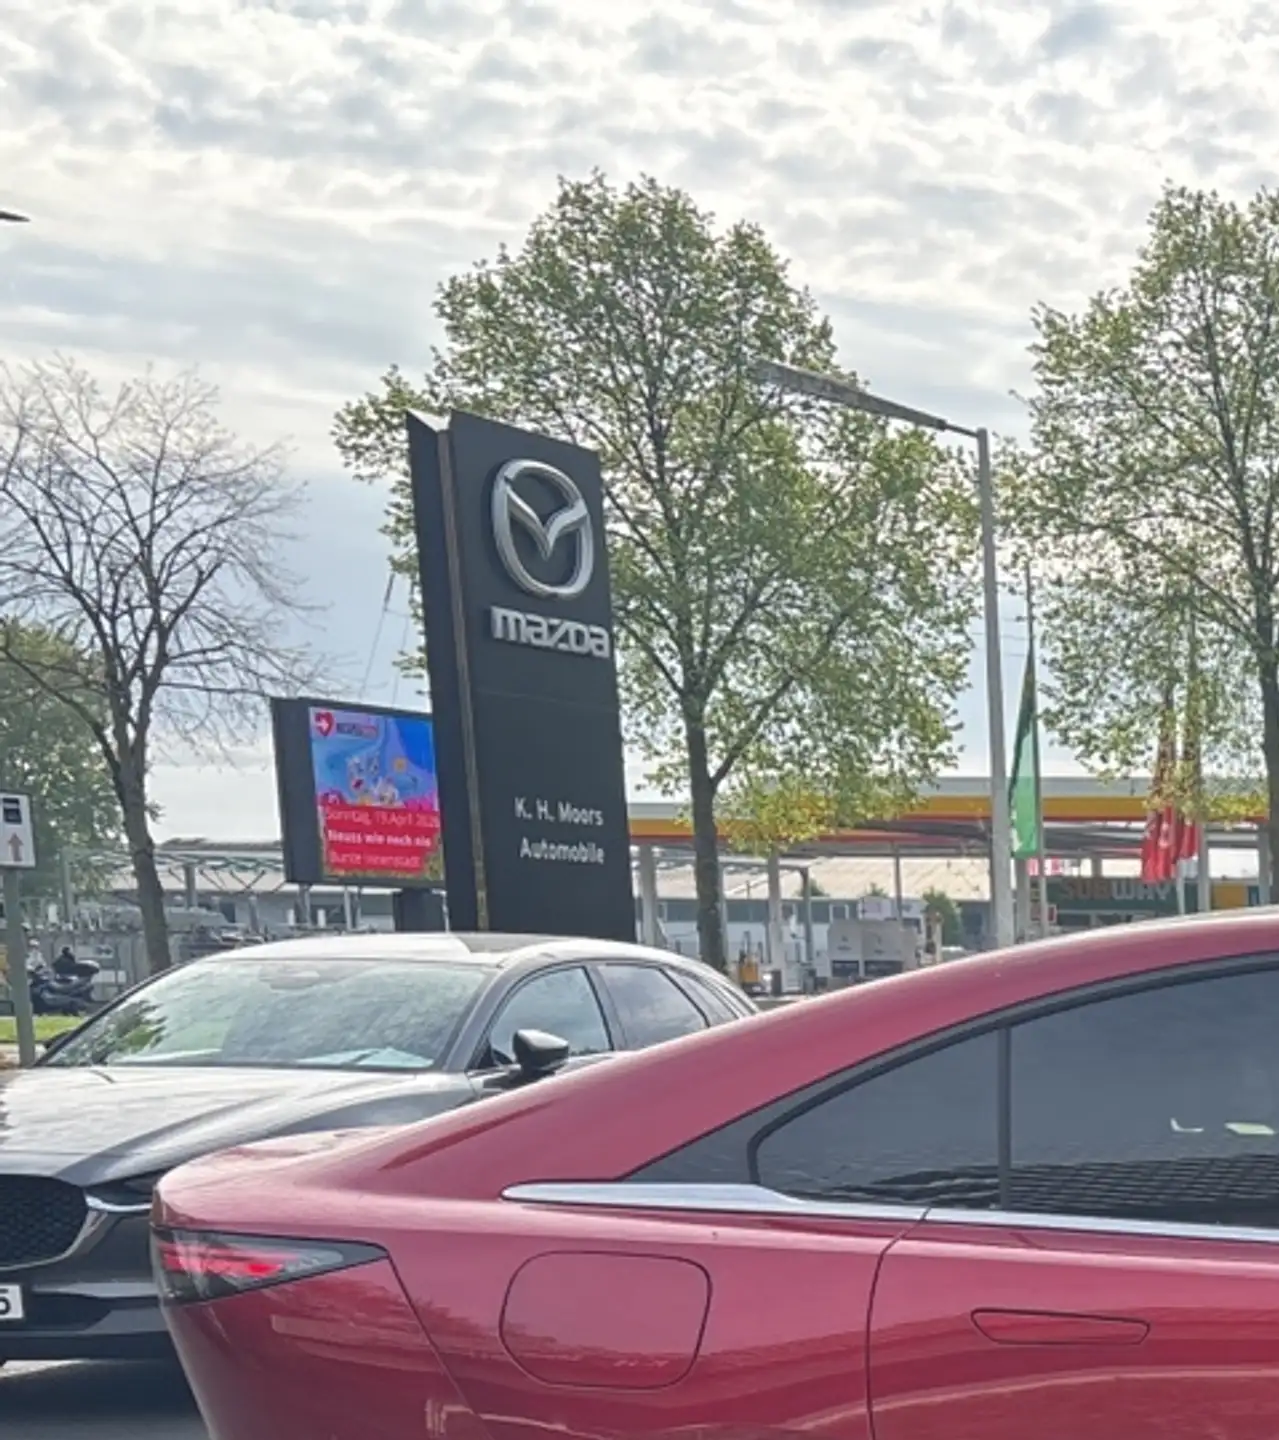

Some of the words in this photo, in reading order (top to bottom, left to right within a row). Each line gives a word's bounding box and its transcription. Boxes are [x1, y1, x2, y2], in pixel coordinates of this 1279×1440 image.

[490, 605, 610, 658] mazda
[514, 797, 533, 820] K.
[536, 798, 555, 822] H.
[557, 801, 604, 826] Moors
[520, 836, 604, 865] Automobile
[1063, 877, 1173, 901] SUBWAY
